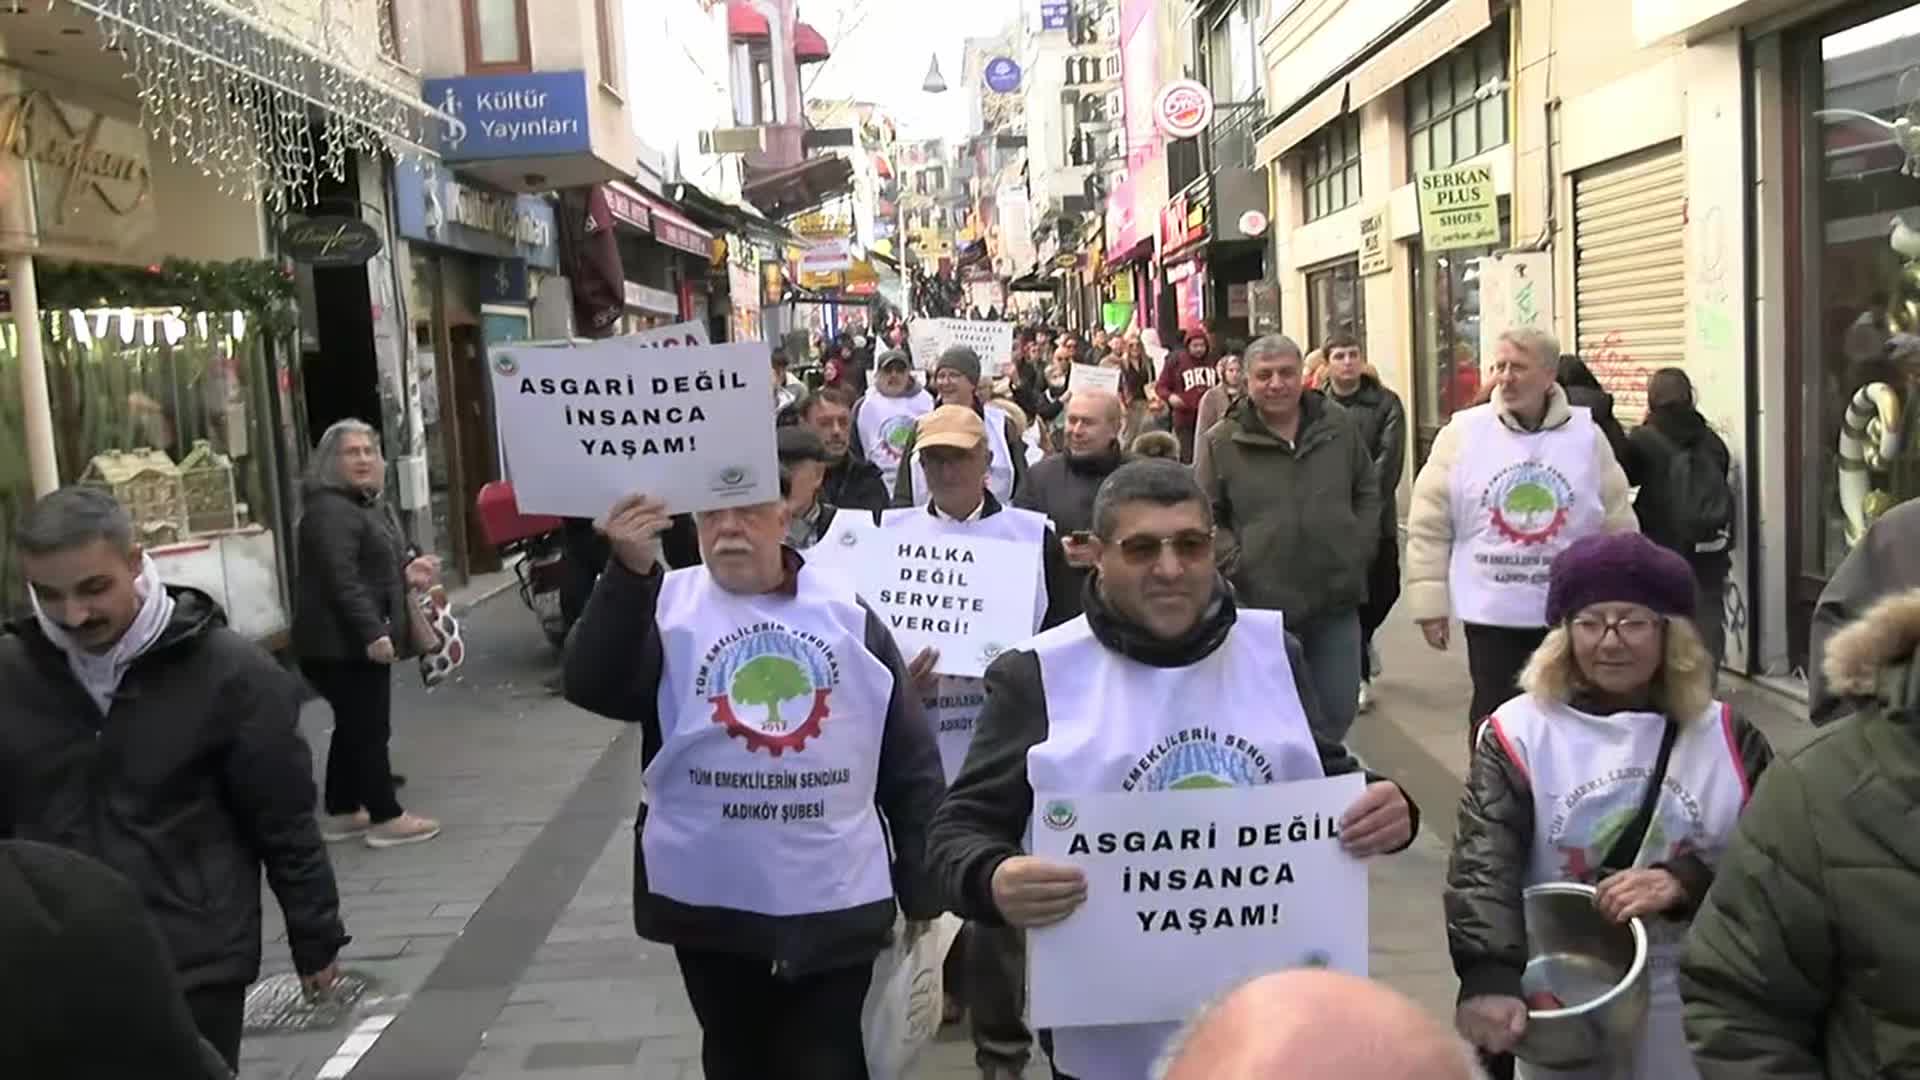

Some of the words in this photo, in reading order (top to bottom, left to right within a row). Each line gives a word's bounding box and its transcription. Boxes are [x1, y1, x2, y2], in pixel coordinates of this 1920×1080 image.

[476, 88, 548, 112] Kültür
[480, 116, 577, 141] Yayınları
[1422, 168, 1490, 190] SERKAN
[1437, 187, 1481, 205] PLUS
[1440, 212, 1482, 226] SHOES
[519, 374, 635, 395] ASGARİ
[651, 369, 748, 395] DEĞİL
[564, 405, 706, 426] İNSANCA
[581, 436, 697, 460] YAŞAM!
[897, 543, 975, 563] HALKA
[900, 566, 969, 586] DEĞİL
[880, 589, 984, 612] SERVETE
[890, 613, 969, 635] VERGİ!
[689, 767, 712, 785] TÜM
[714, 769, 797, 790] EMEKLİLERİN
[800, 767, 850, 788] SENDİKASI
[722, 801, 778, 819] KADIKÖY
[781, 799, 824, 823] ŞUBESİ
[1068, 822, 1217, 855] ASGARİ
[1238, 815, 1341, 849] DEĞİL
[1122, 862, 1295, 893] İNSANCA
[1137, 903, 1280, 935] YAŞAM!
